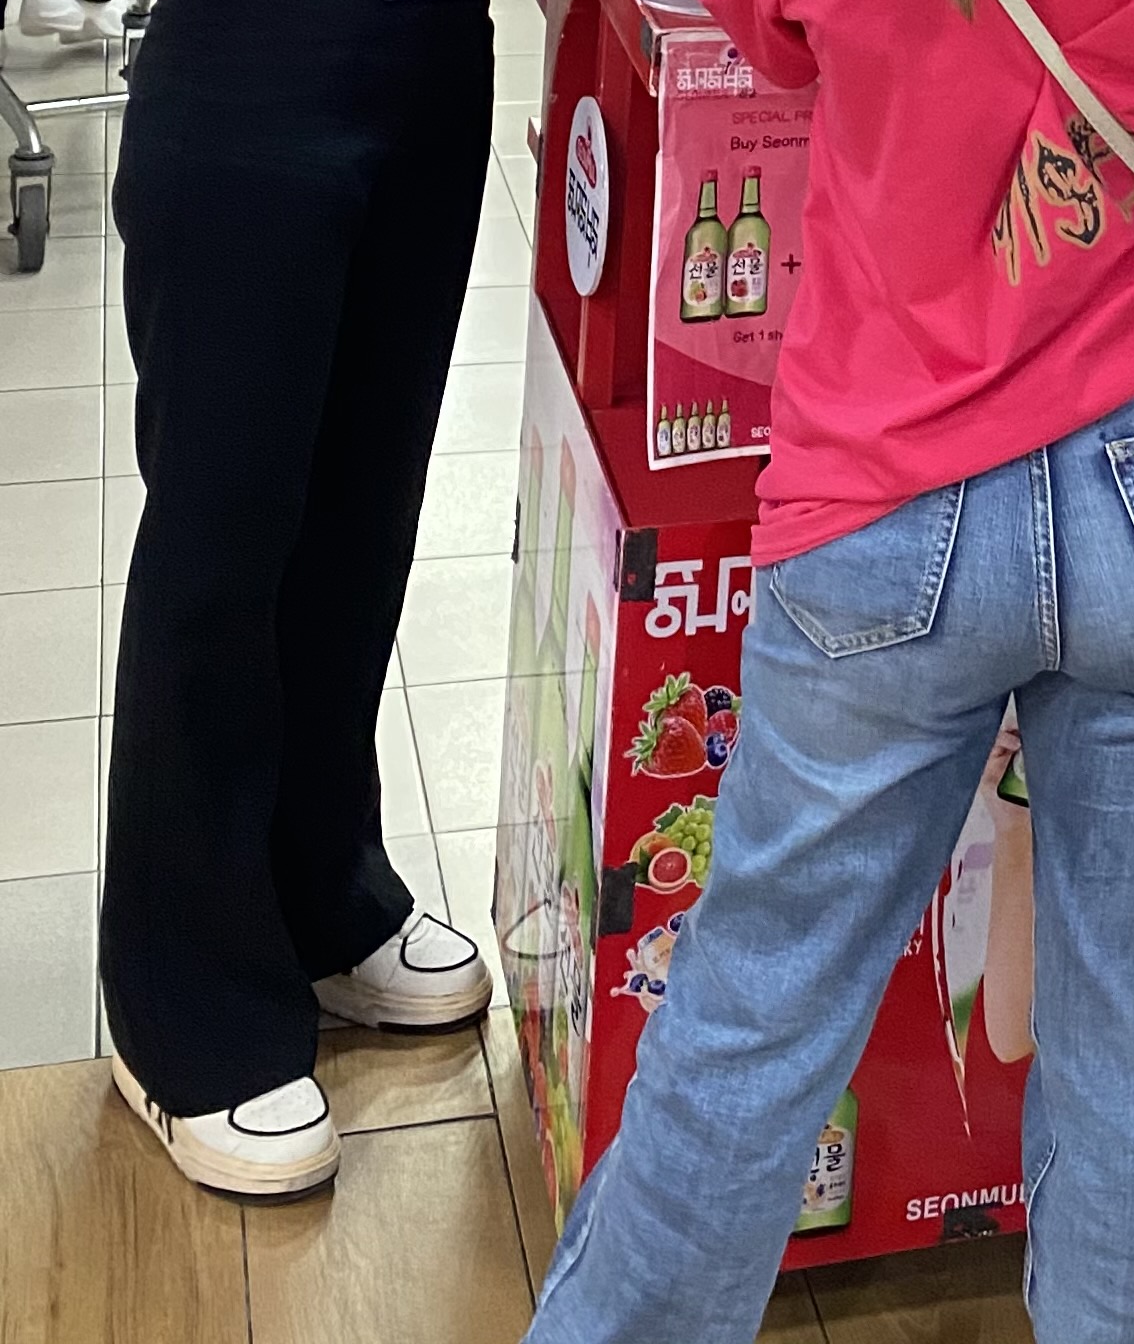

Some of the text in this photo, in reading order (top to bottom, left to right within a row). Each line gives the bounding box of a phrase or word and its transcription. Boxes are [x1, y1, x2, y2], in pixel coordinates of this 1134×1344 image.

[732, 111, 791, 125] SPECIAL
[730, 135, 810, 153] Buy Seonm
[733, 331, 755, 343] Get
